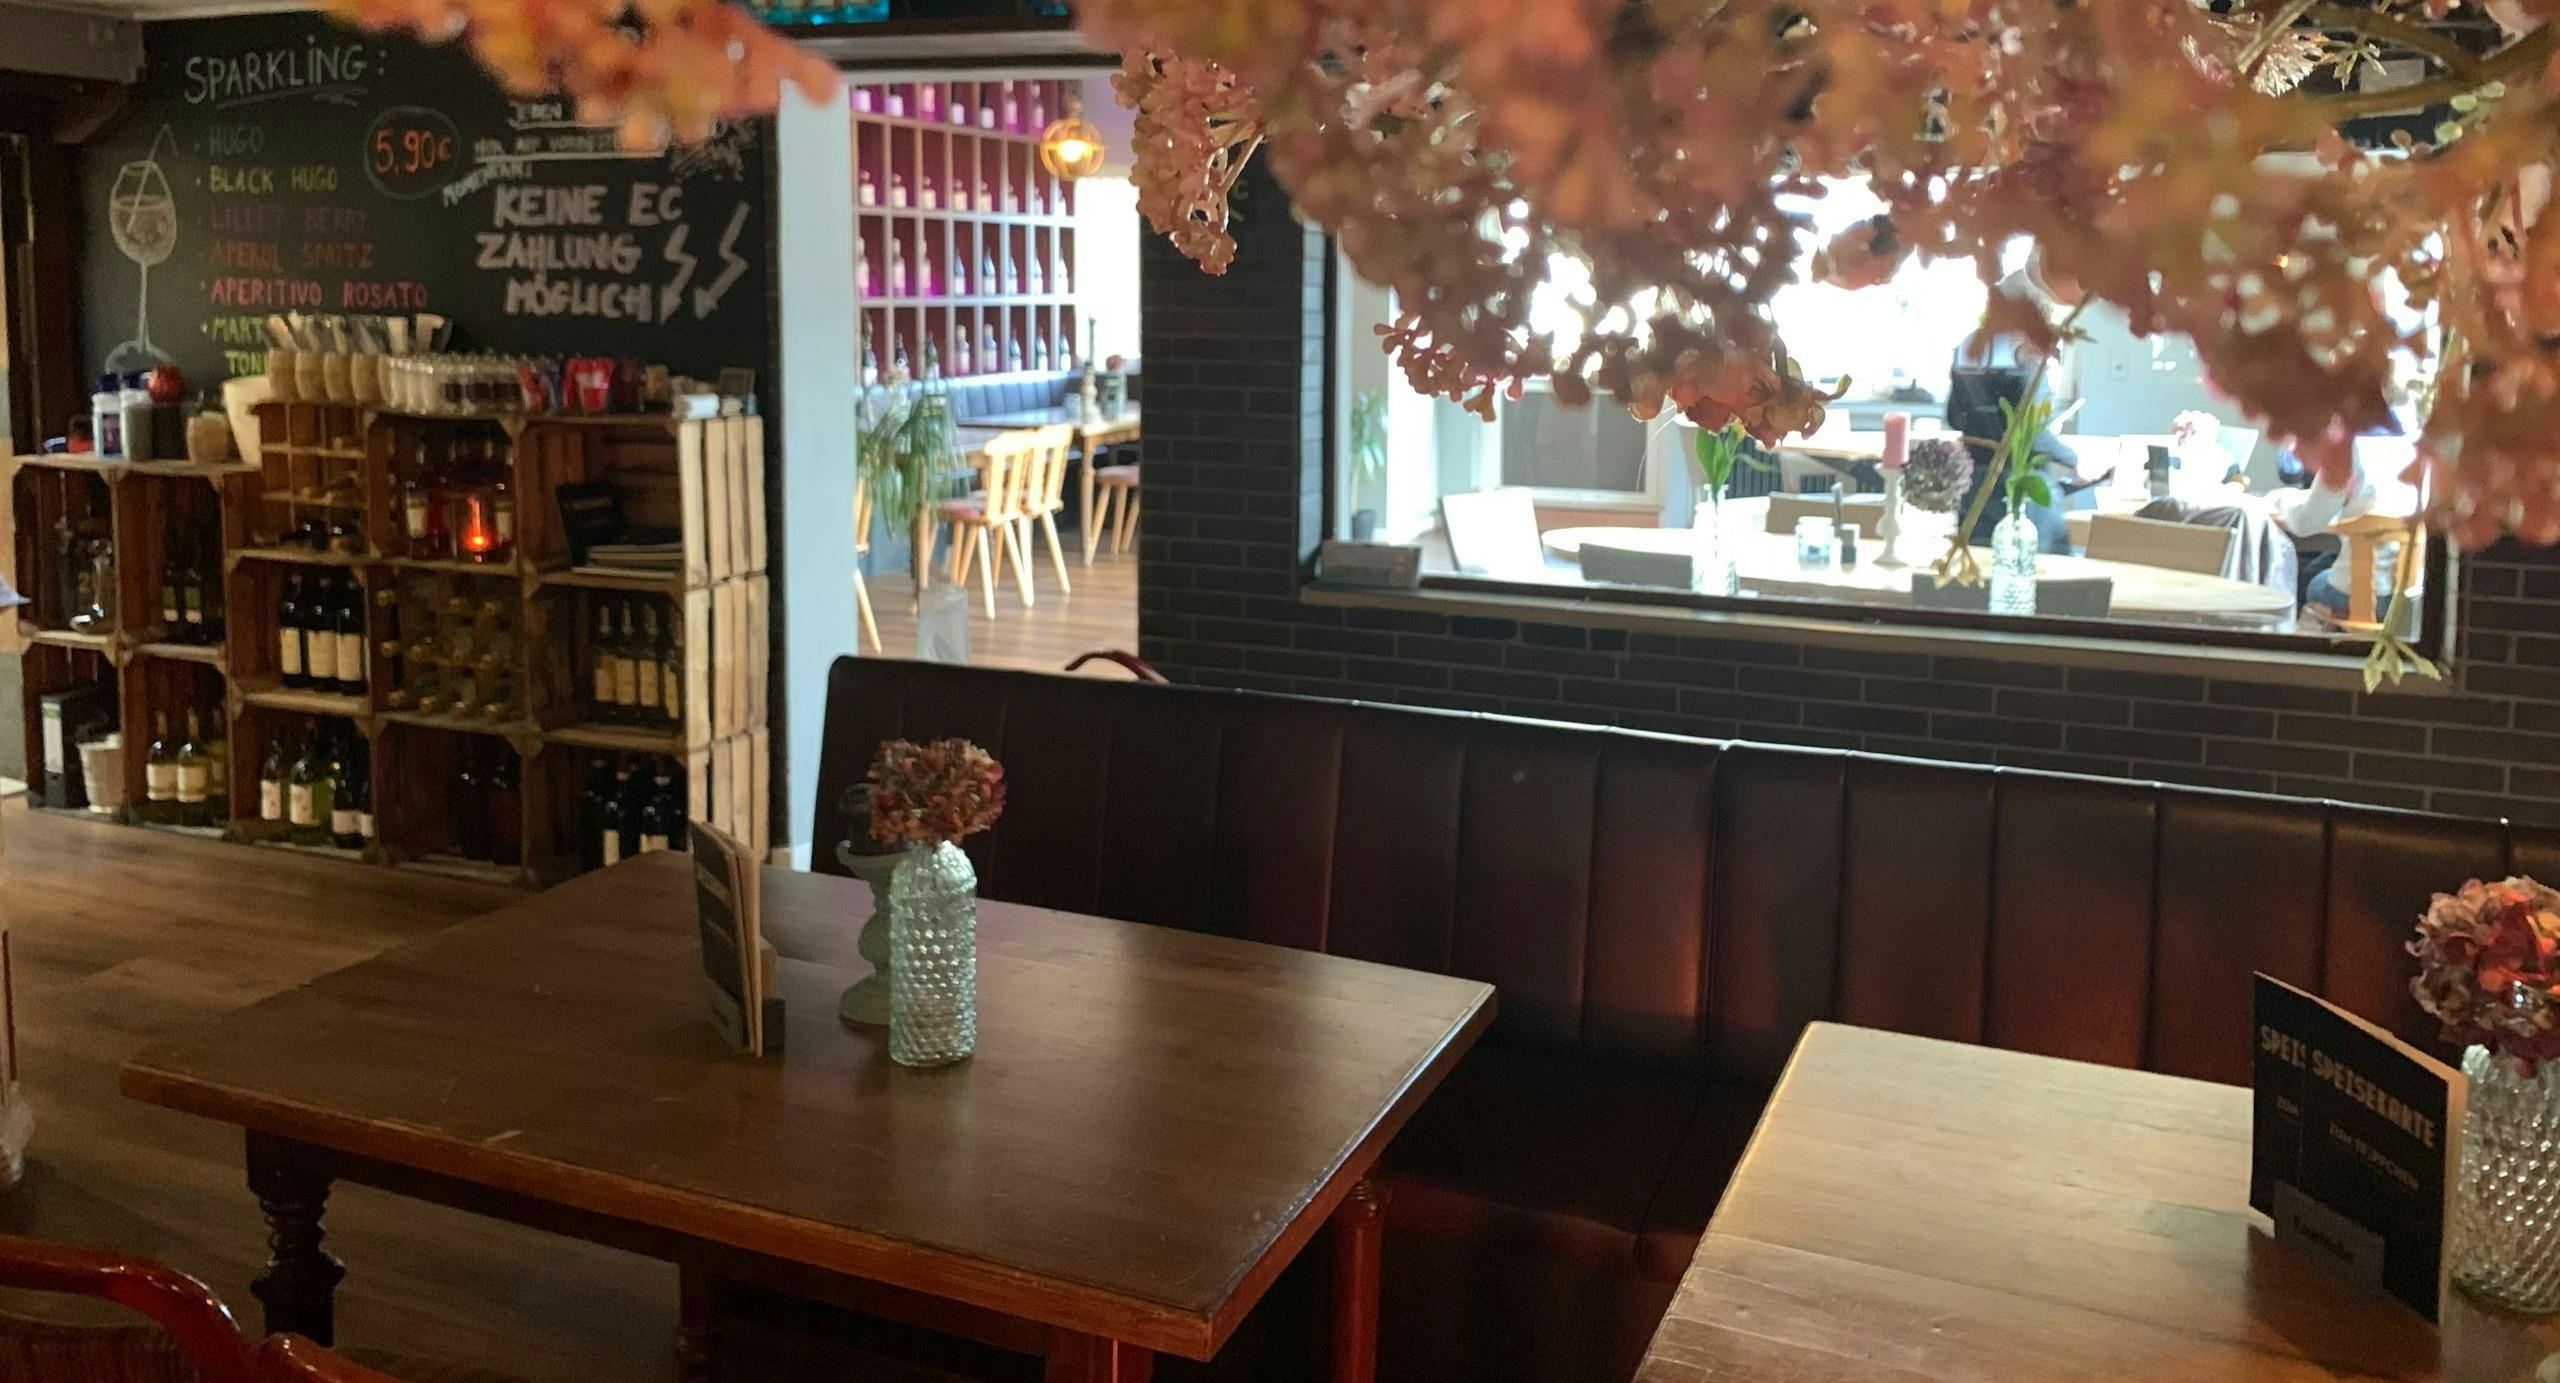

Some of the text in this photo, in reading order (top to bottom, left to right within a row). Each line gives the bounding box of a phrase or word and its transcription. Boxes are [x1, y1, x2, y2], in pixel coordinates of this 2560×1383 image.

[209, 165, 339, 193] BLACK HUGO
[492, 181, 685, 229] KEINE EC
[474, 231, 643, 275] ZAHLUNG
[210, 276, 429, 309] APERITIVO ROSATO
[2311, 1050, 2436, 1149] SPEISEKARTE
